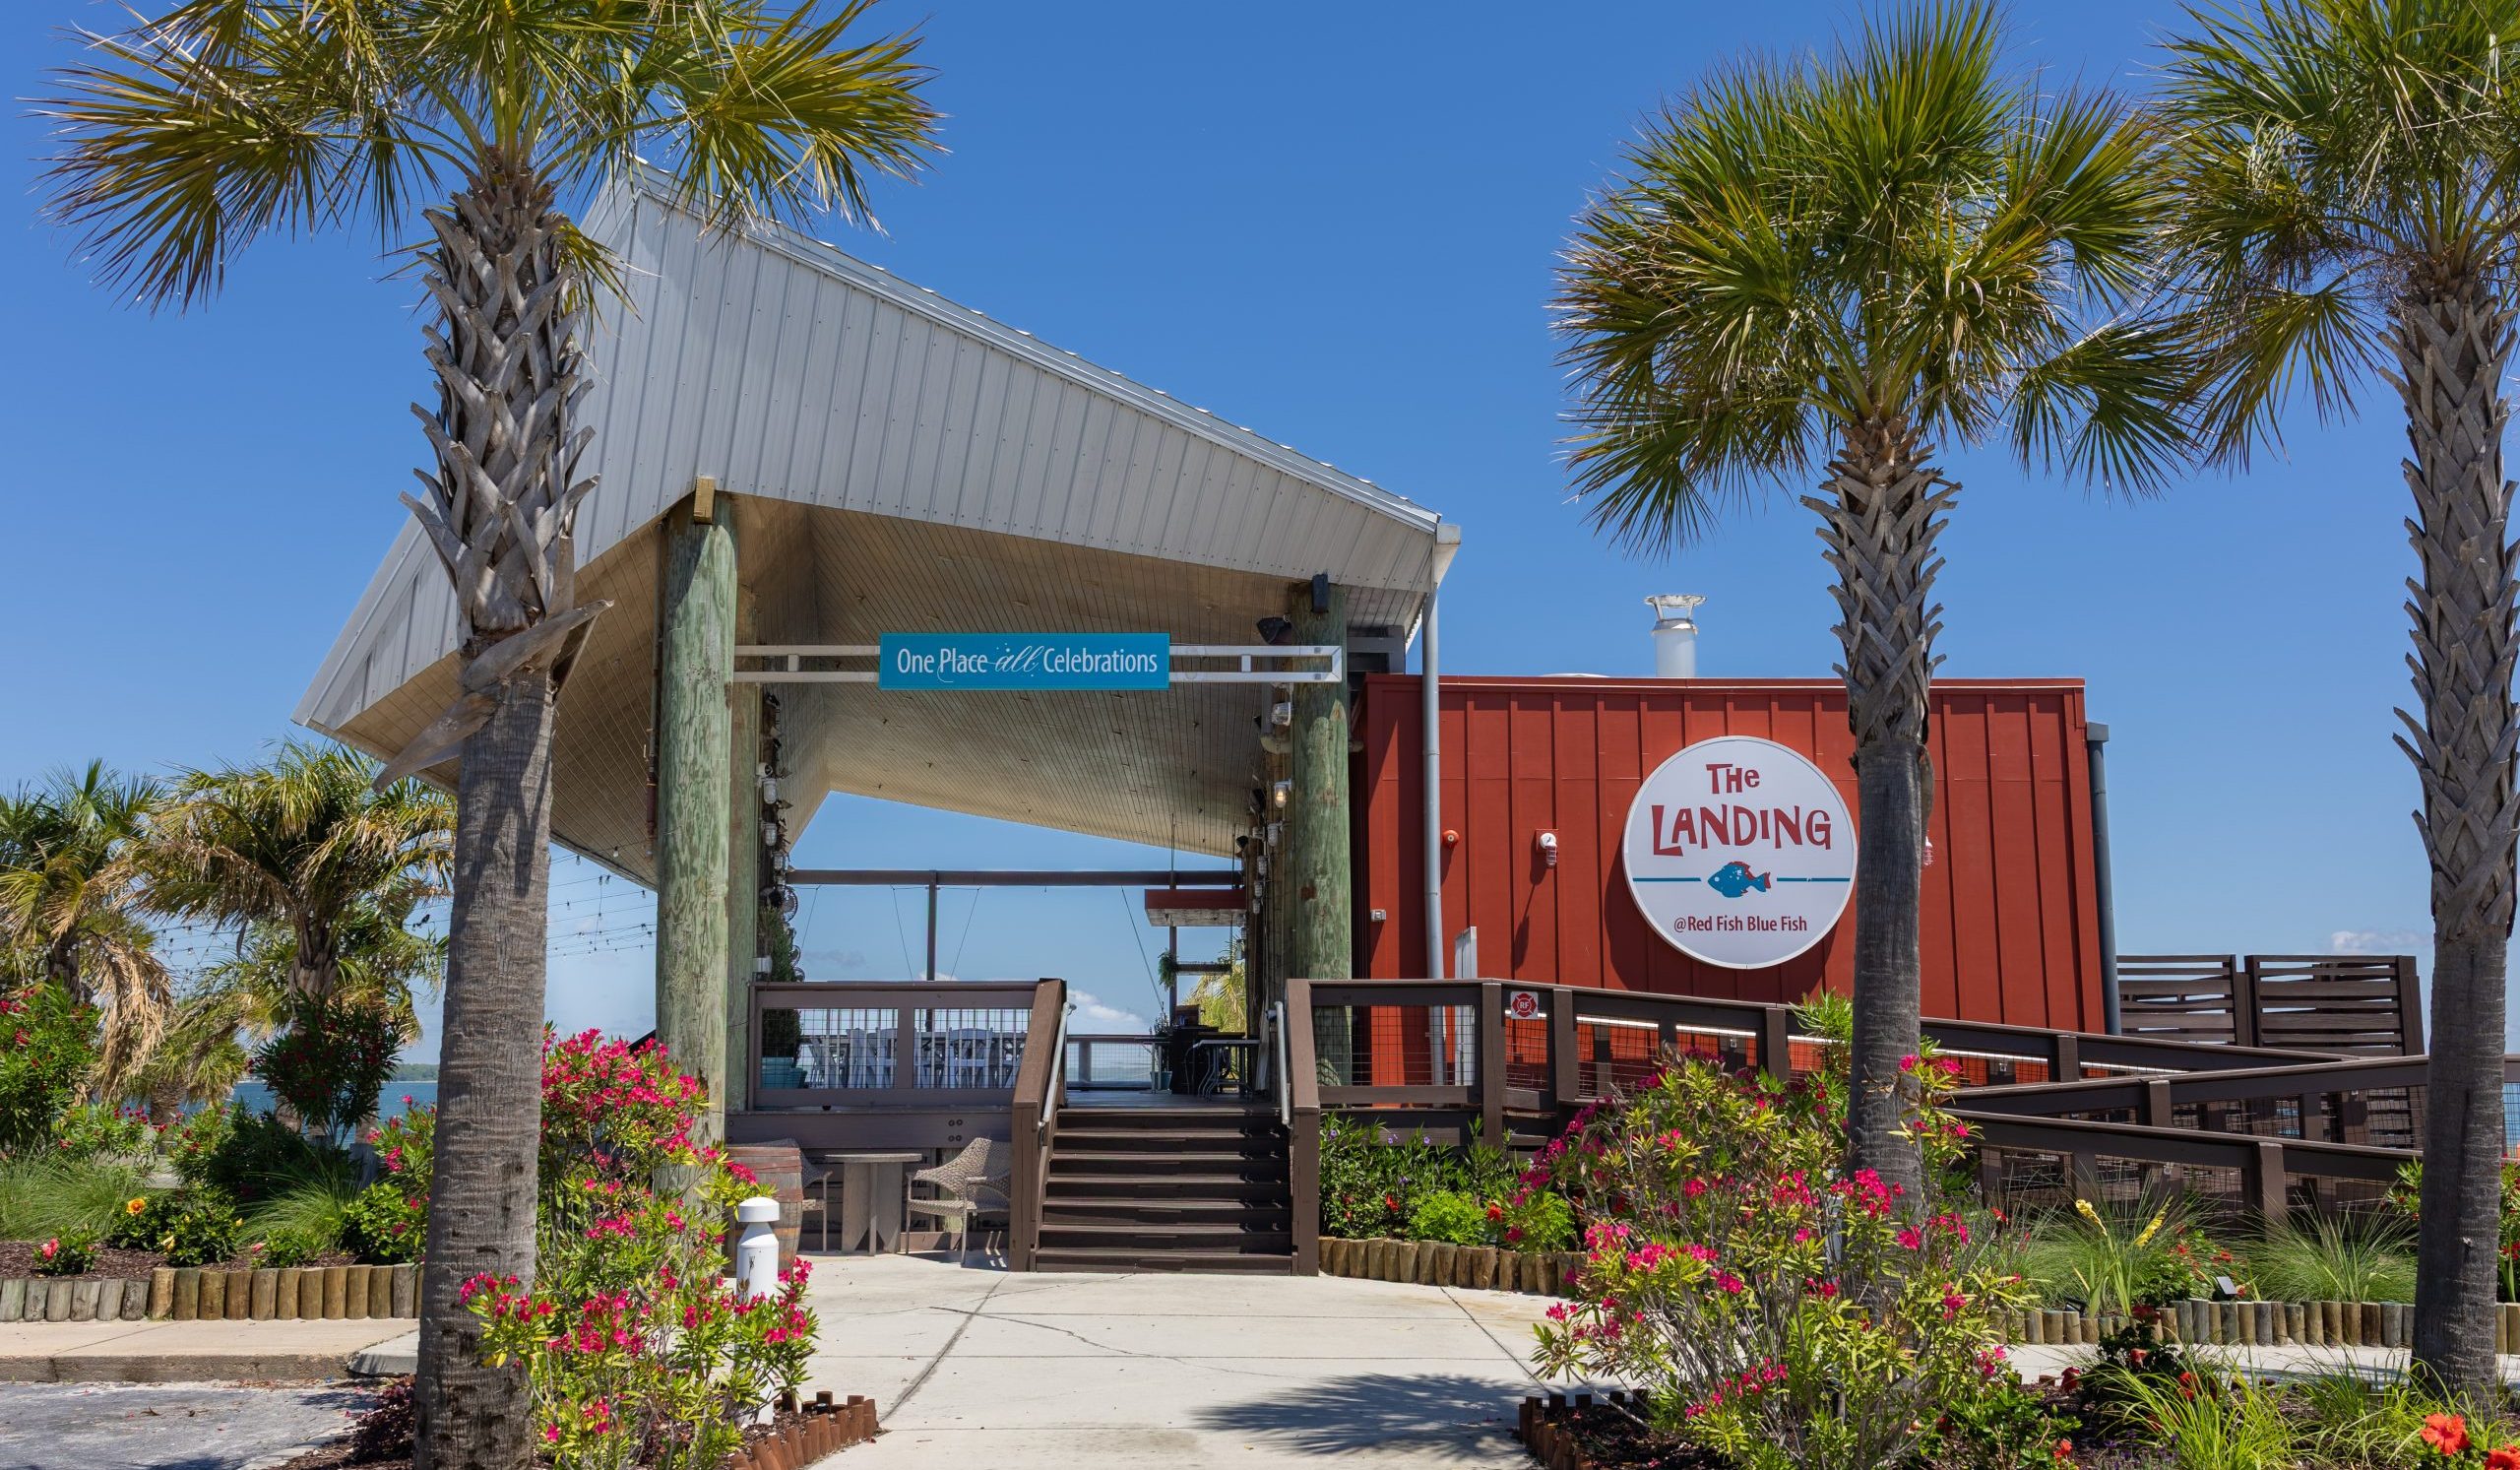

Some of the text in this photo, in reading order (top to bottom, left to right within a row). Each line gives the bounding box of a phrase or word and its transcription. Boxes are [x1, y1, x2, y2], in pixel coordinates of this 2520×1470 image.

[897, 645, 1158, 673] One Place all Celebrations
[1652, 804, 1832, 857] LANDING
[1674, 915, 1807, 933] @Red Fish Blue Fish
